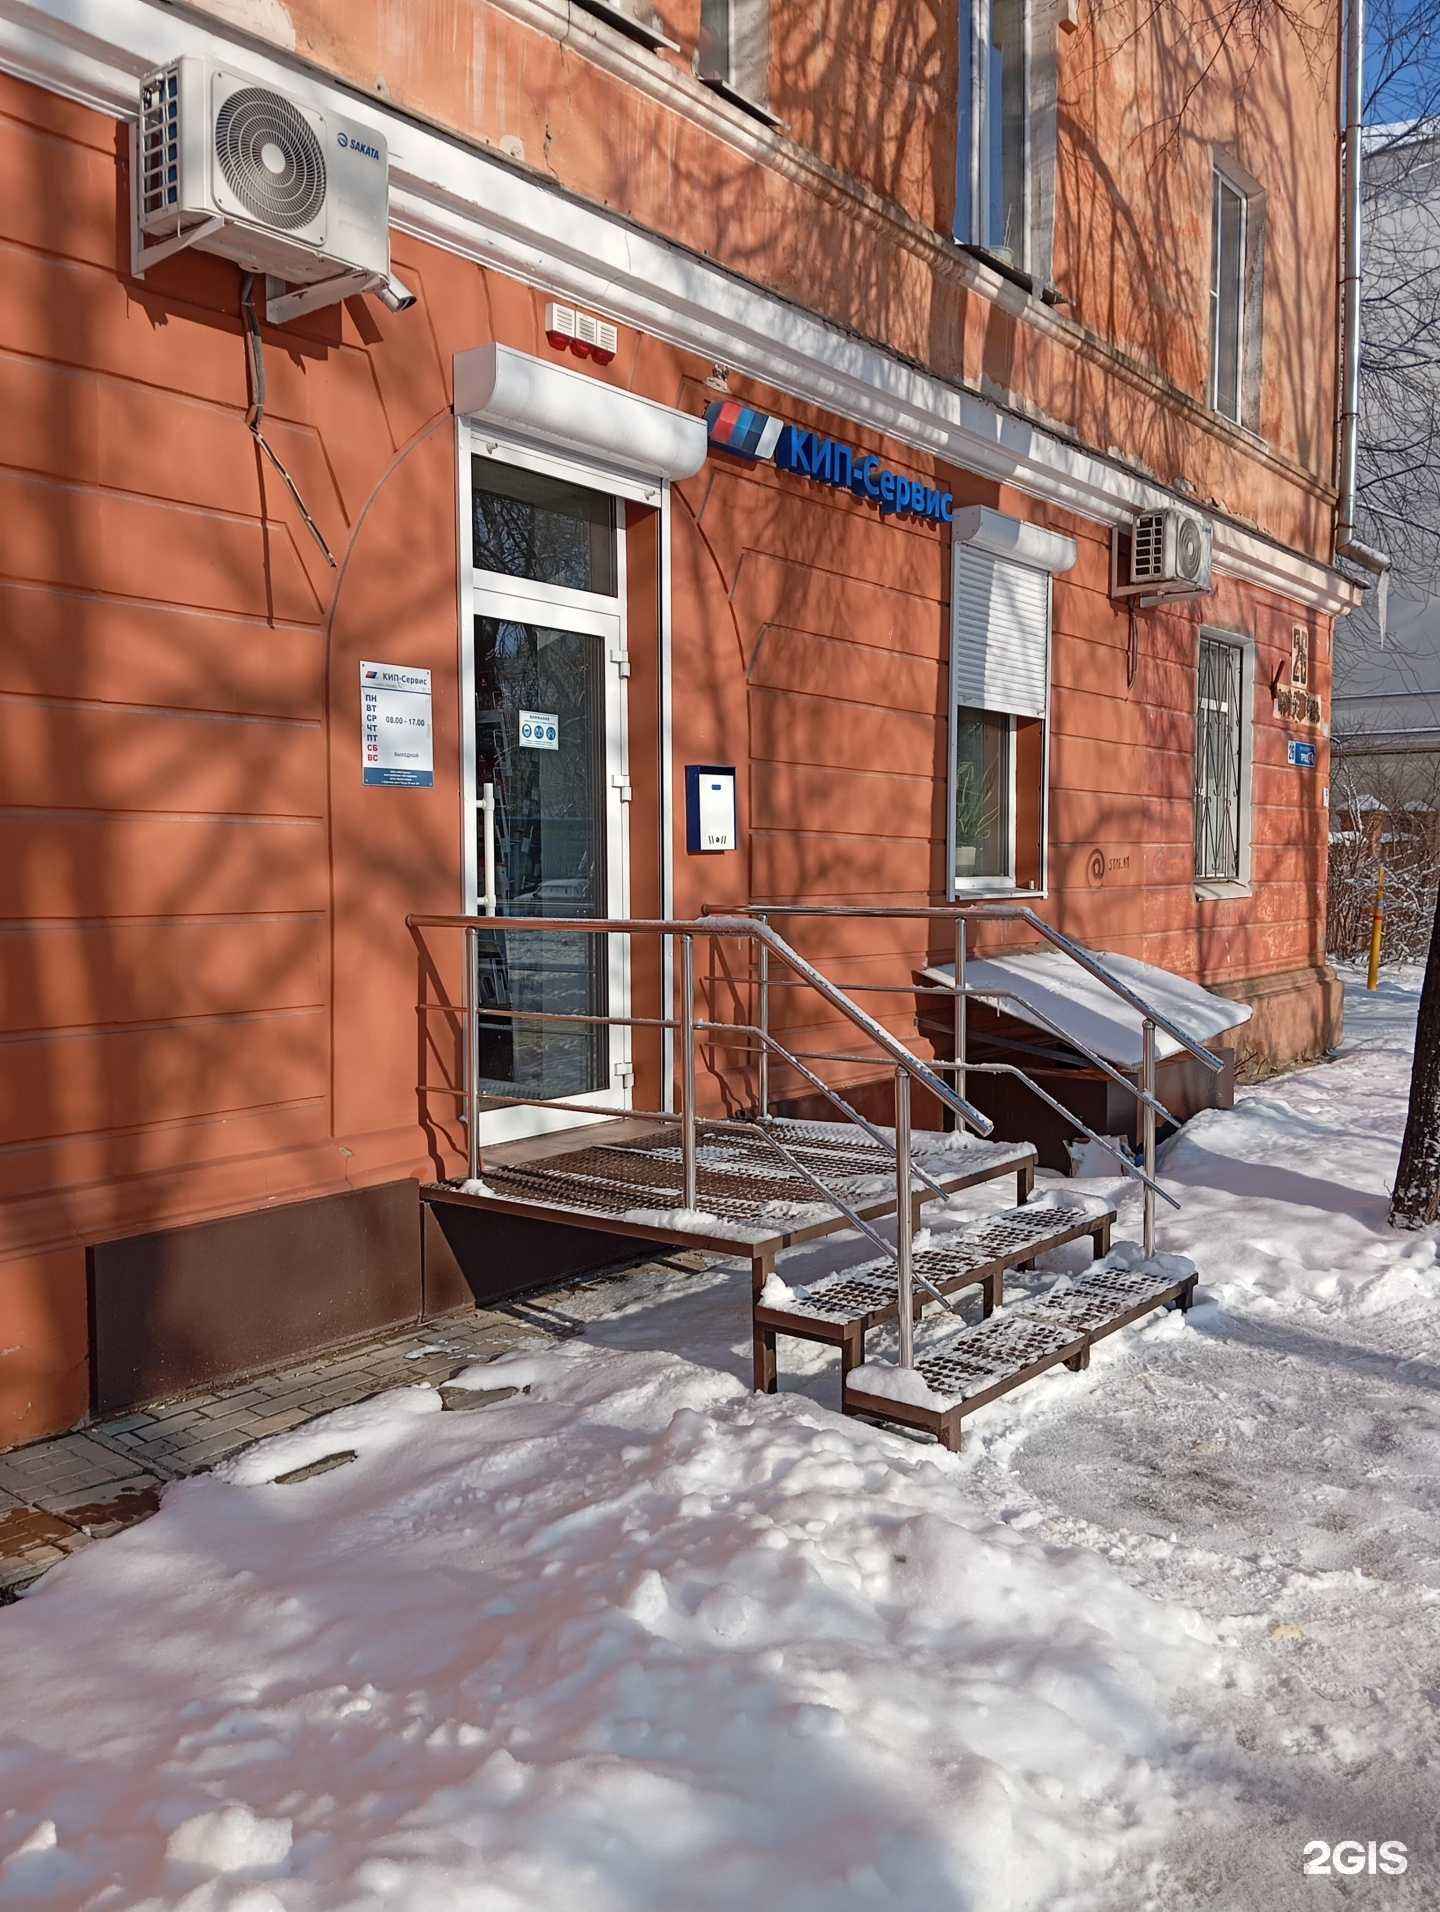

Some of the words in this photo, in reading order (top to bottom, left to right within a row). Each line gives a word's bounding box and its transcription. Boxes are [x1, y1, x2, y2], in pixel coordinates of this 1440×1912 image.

[350, 139, 379, 160] SAKATA
[788, 423, 954, 522] КИП-Сервис
[382, 672, 428, 686] КИП-Сервис
[365, 694, 377, 703] ПН
[366, 704, 377, 713] ВТ
[366, 714, 377, 722] СР
[408, 718, 425, 728] 17.00
[366, 724, 378, 732] ЧТ
[366, 734, 378, 742] ПТ
[367, 744, 378, 752] СБ
[367, 754, 378, 762] ВС
